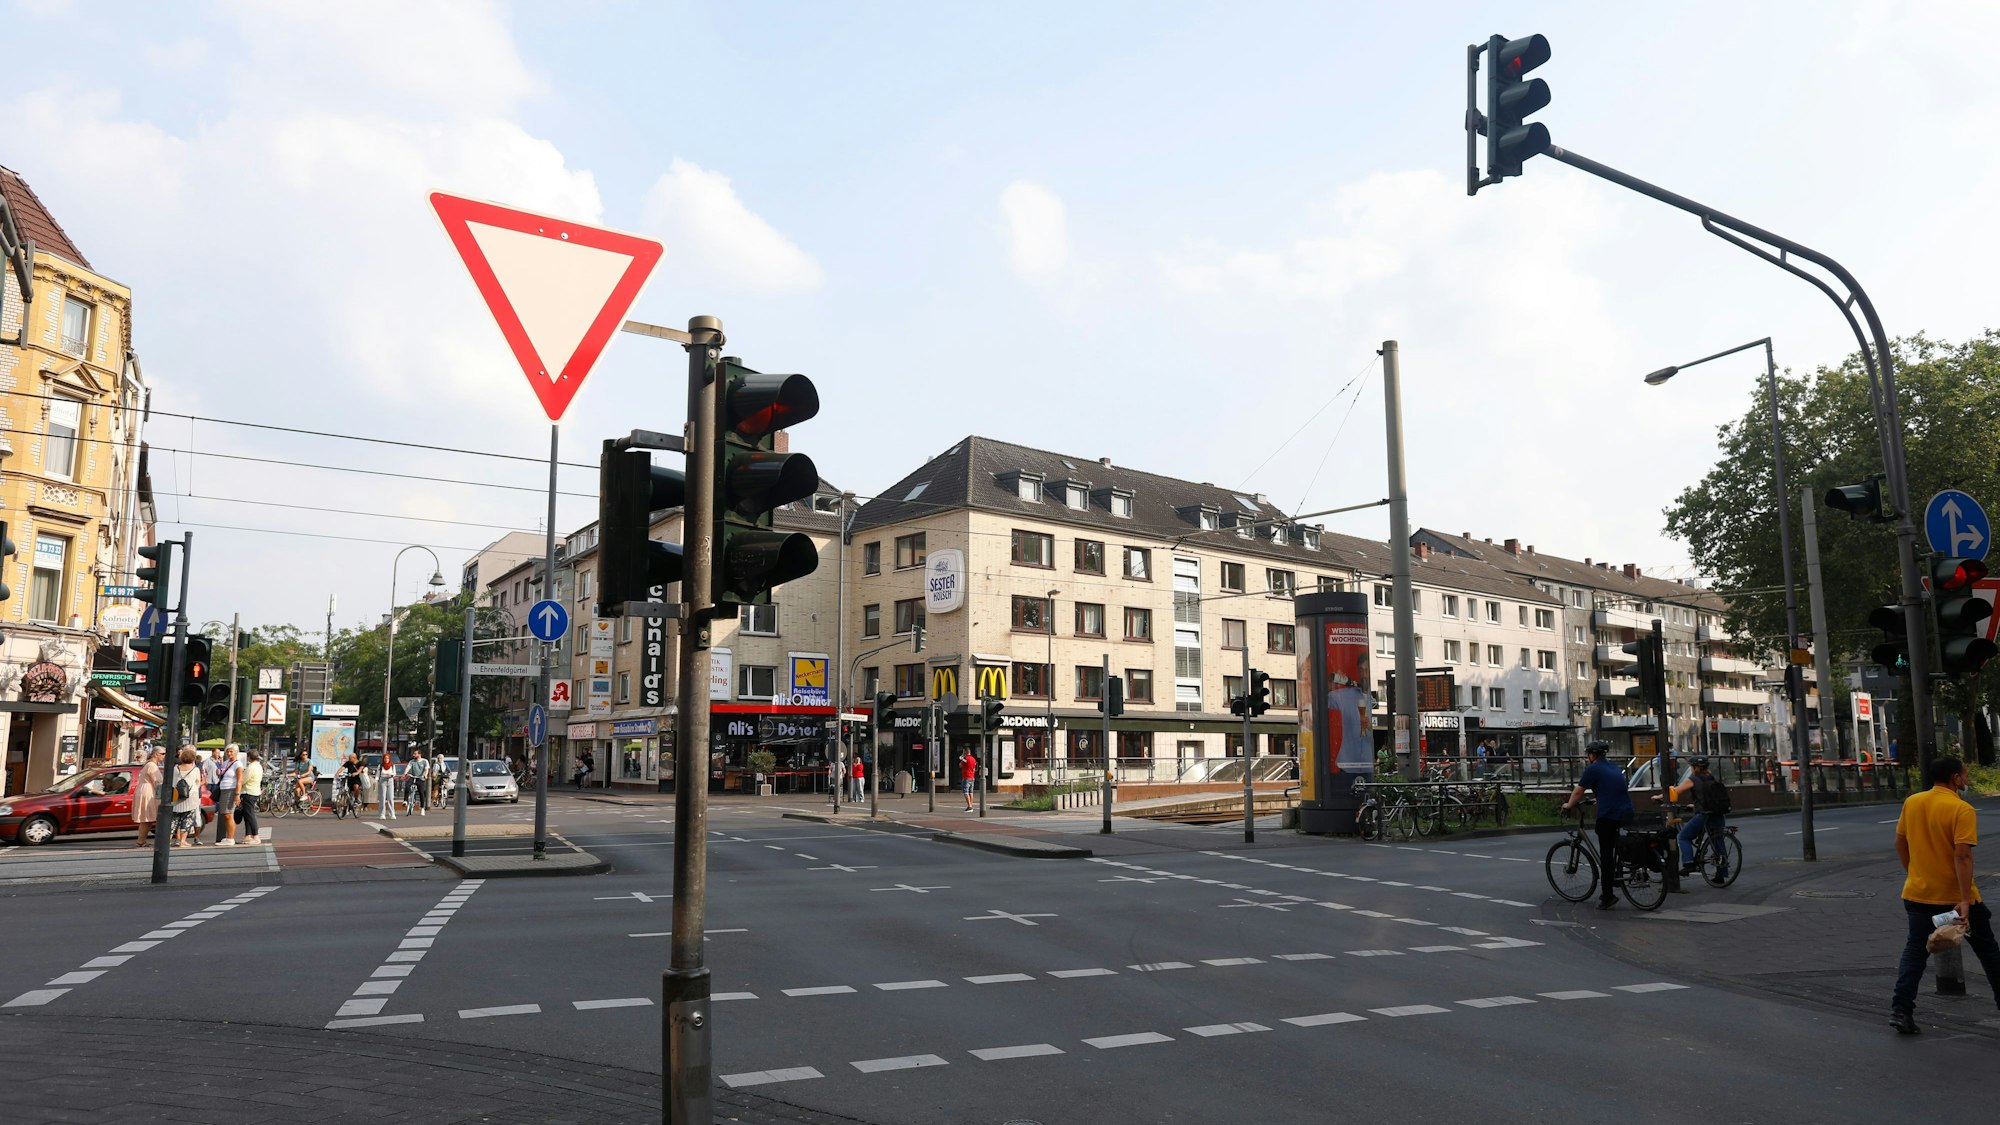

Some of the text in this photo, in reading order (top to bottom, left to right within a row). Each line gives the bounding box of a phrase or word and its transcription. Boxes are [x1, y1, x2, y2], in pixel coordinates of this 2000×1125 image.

[930, 574, 955, 592] SESTER
[118, 588, 125, 596] 99
[126, 588, 134, 596] 73
[480, 666, 528, 674] Ehrenfeldgürtel
[313, 704, 322, 714] U
[728, 720, 754, 736] Ali's
